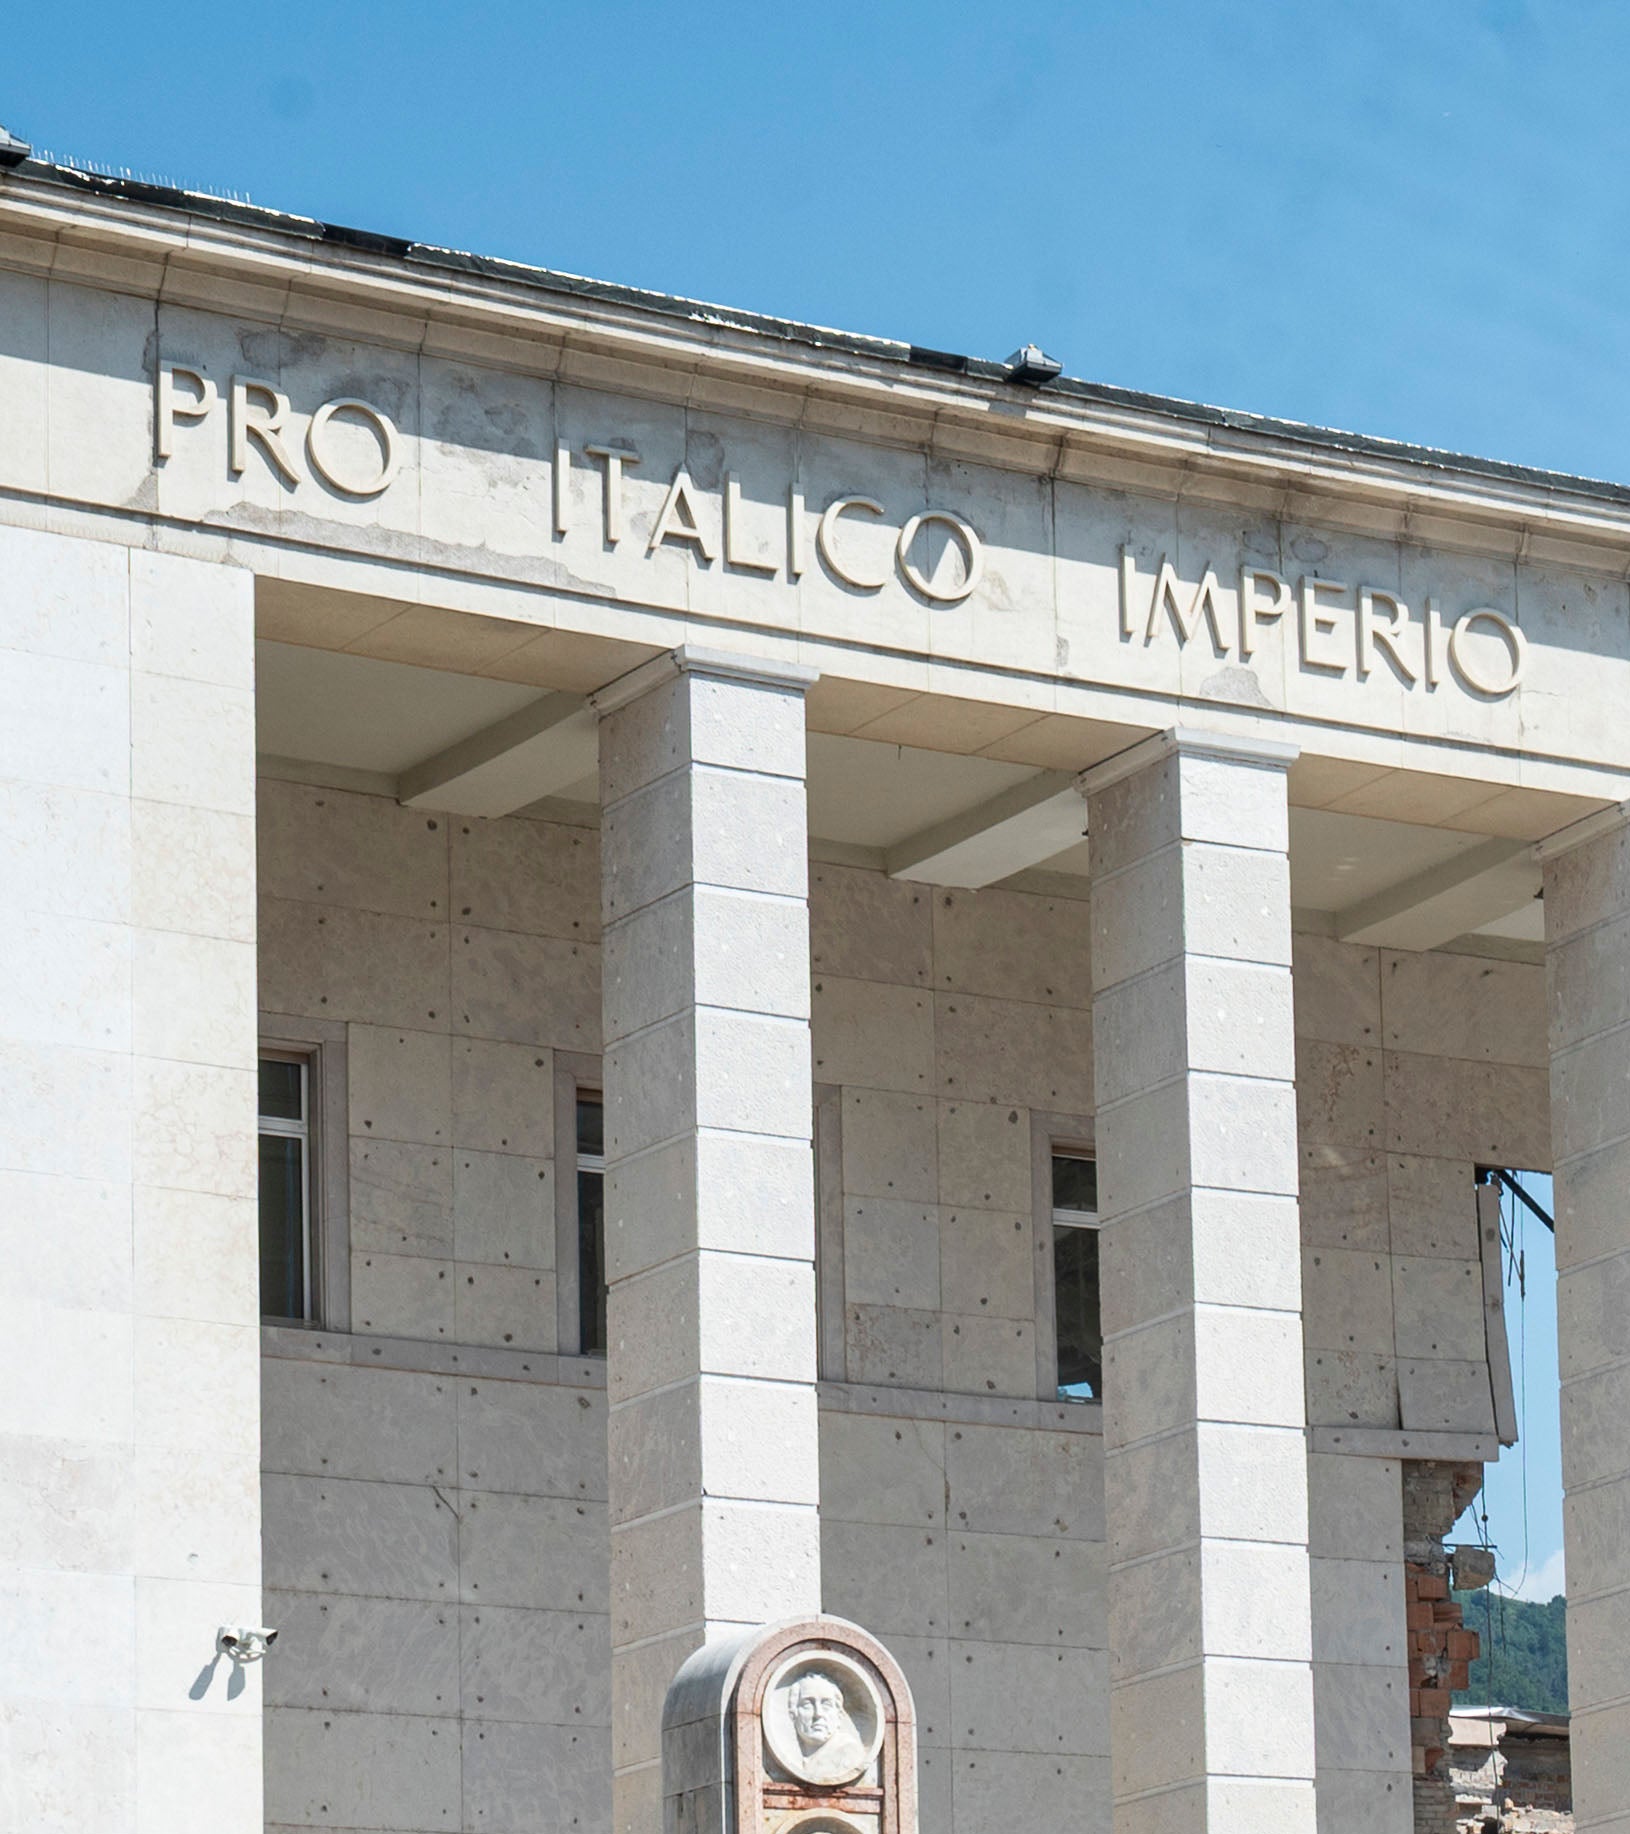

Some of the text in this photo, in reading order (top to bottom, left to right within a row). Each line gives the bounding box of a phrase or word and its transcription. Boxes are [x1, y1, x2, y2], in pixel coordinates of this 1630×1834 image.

[156, 359, 400, 496] PRO
[554, 437, 984, 601] ITALICO
[1119, 543, 1527, 695] IMPERIO
